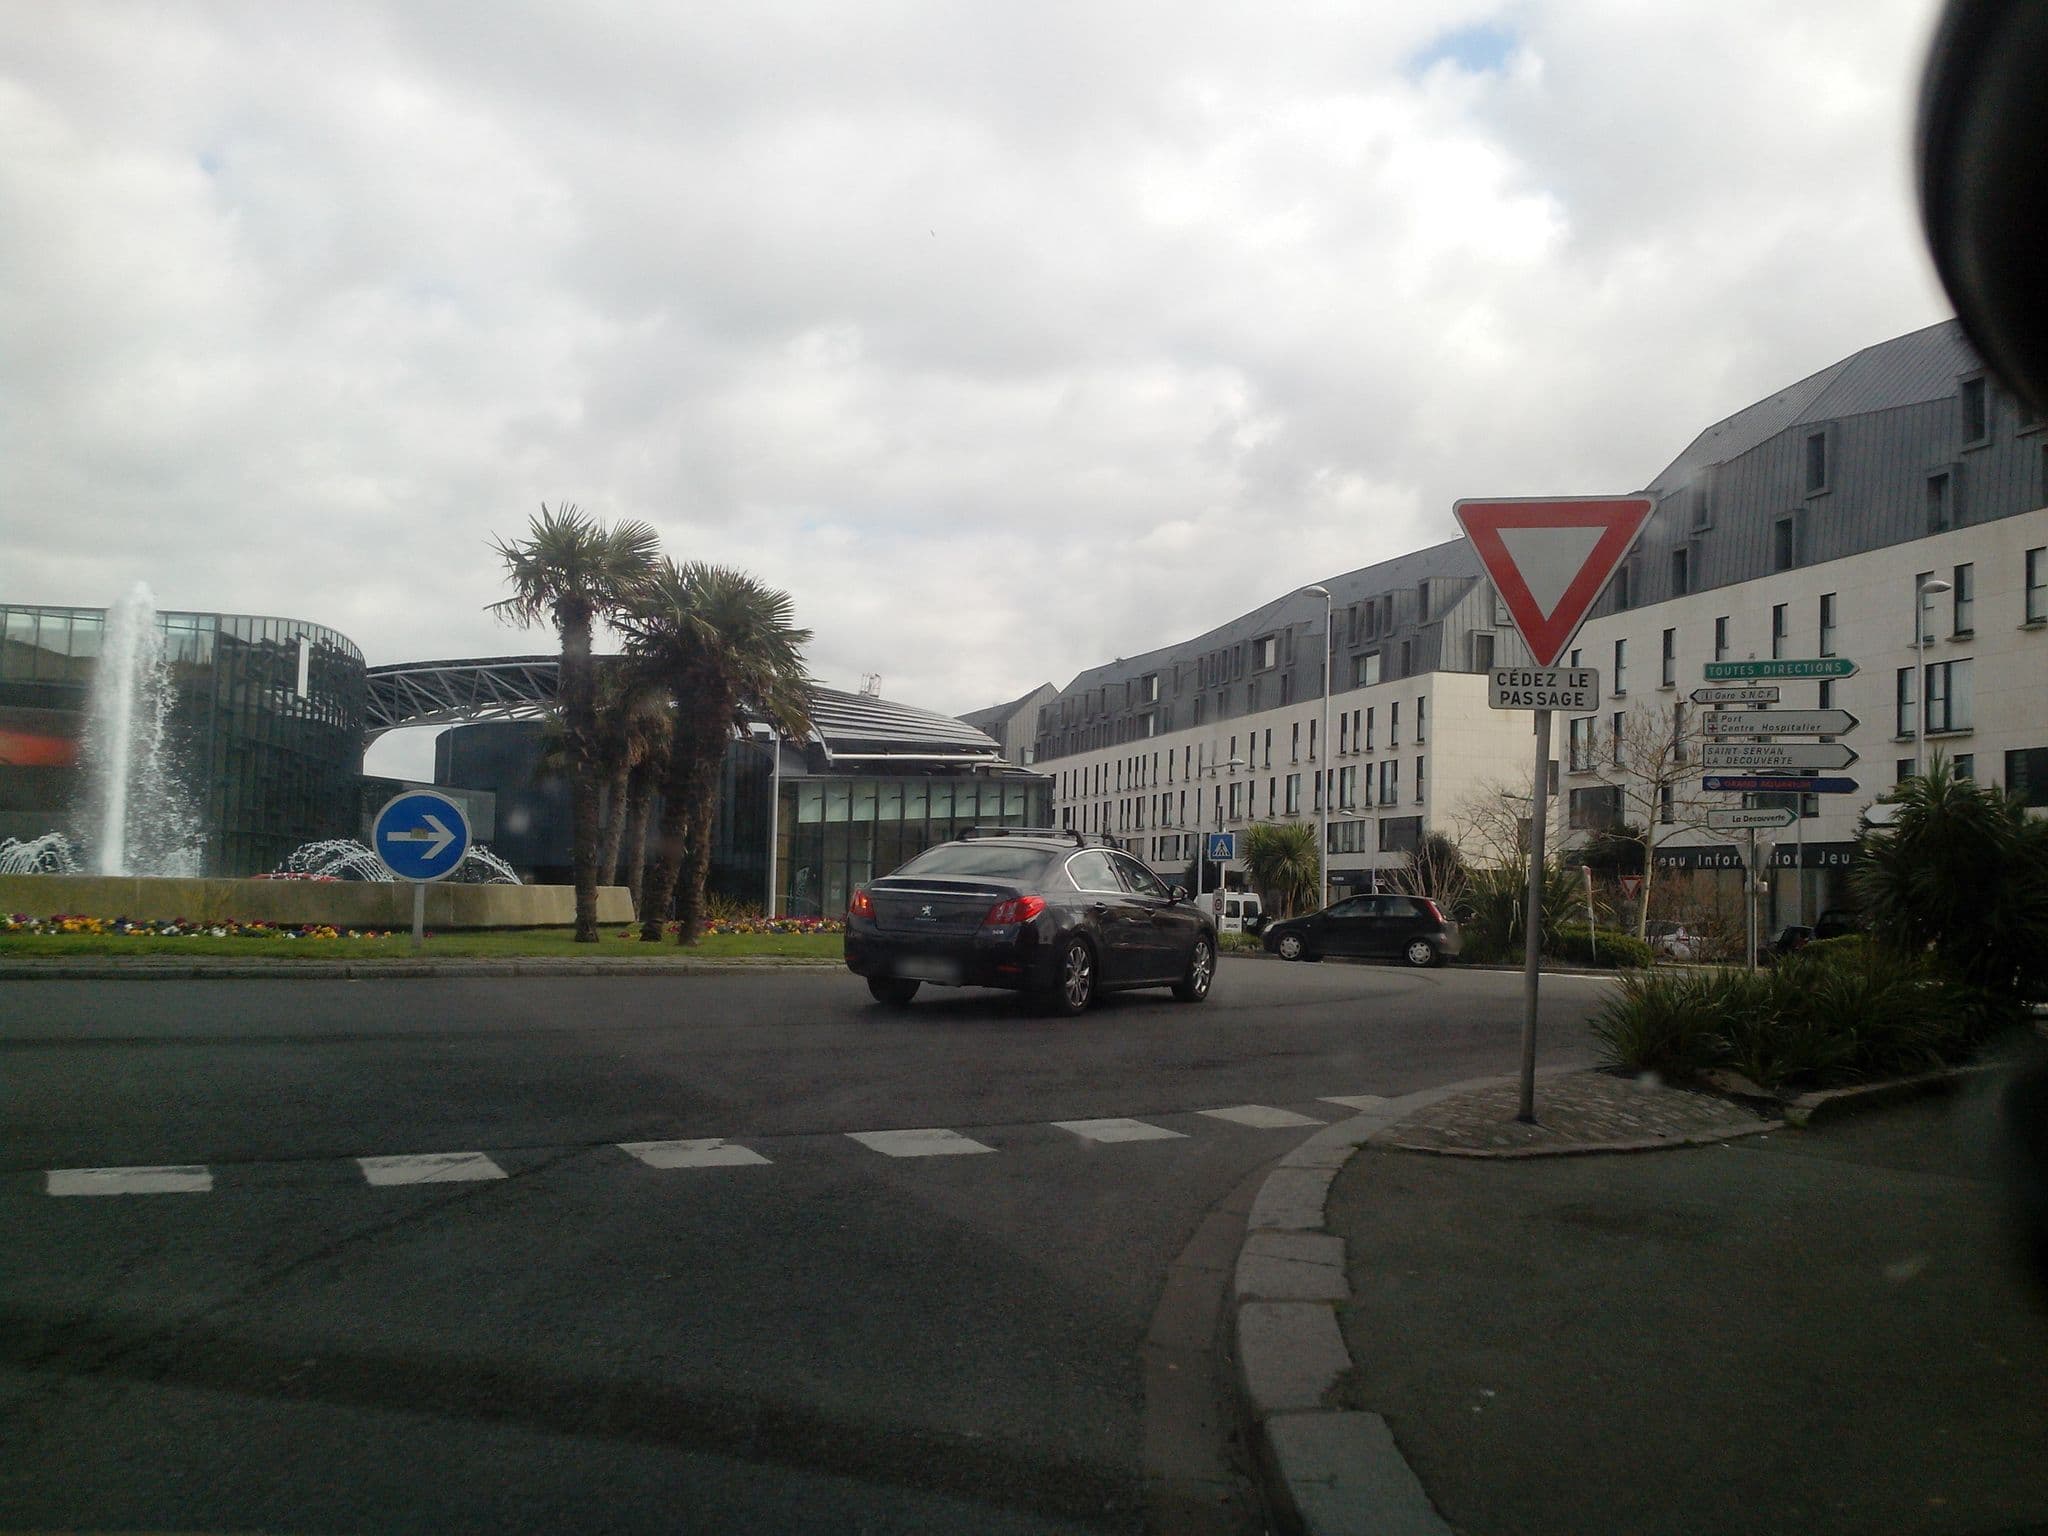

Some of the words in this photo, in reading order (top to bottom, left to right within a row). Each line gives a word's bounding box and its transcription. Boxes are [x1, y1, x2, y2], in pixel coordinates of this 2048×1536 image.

[1710, 664, 1754, 677] TOUTES
[1763, 662, 1842, 675] DIRECTIONS
[1497, 669, 1557, 688] CÉDEZ
[1569, 673, 1589, 688] LE
[1500, 691, 1585, 707] PASSAGE
[1721, 714, 1743, 723] Port
[1721, 724, 1755, 732] Centre
[1762, 723, 1822, 733] Hospitalier
[1706, 757, 1719, 765] LA
[1732, 815, 1741, 823] La
